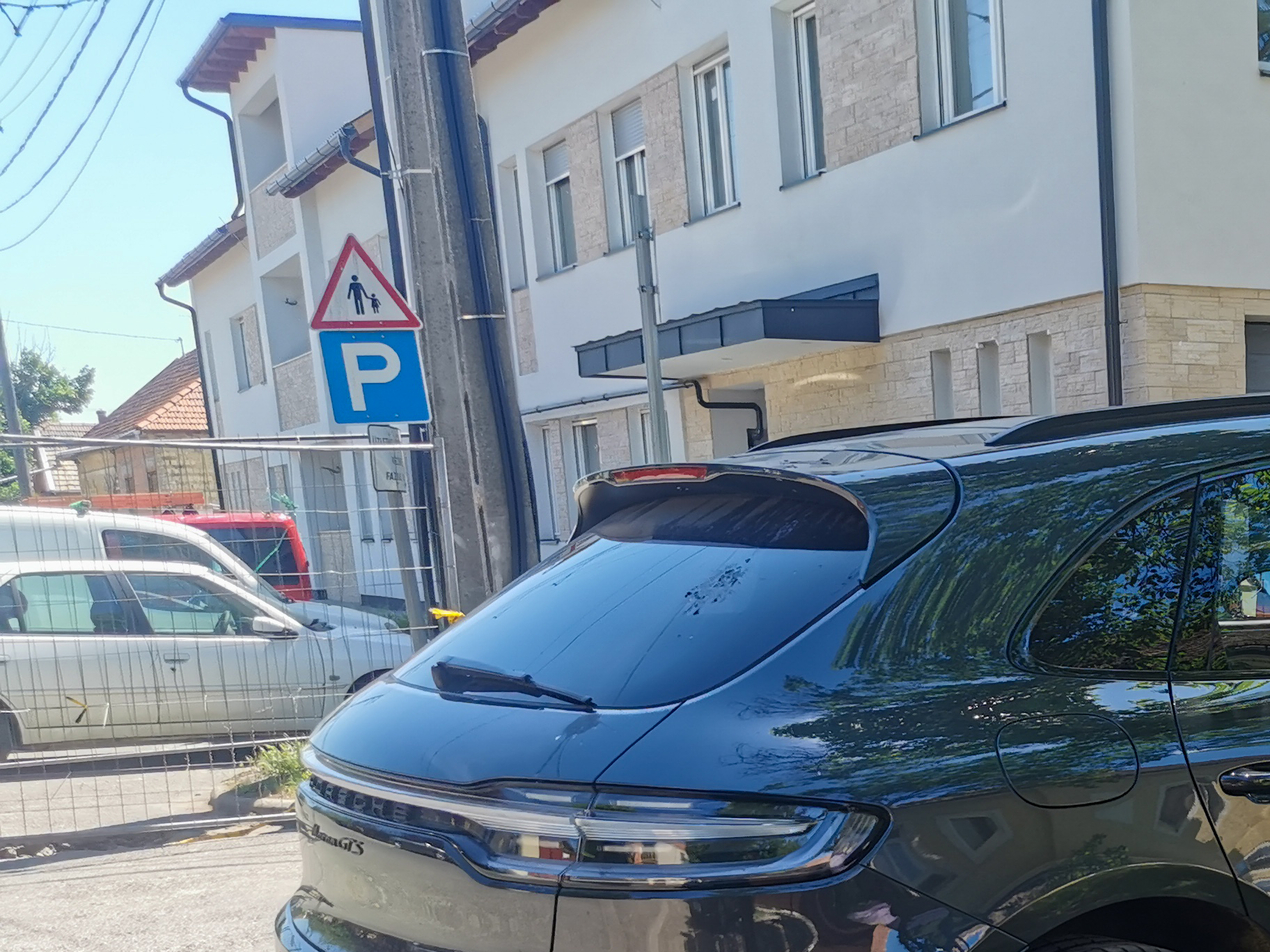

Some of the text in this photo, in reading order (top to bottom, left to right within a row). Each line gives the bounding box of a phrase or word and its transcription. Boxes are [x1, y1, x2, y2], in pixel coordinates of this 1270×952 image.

[341, 342, 401, 411] P
[309, 776, 408, 823] ORSCHE
[339, 836, 364, 856] GTS
